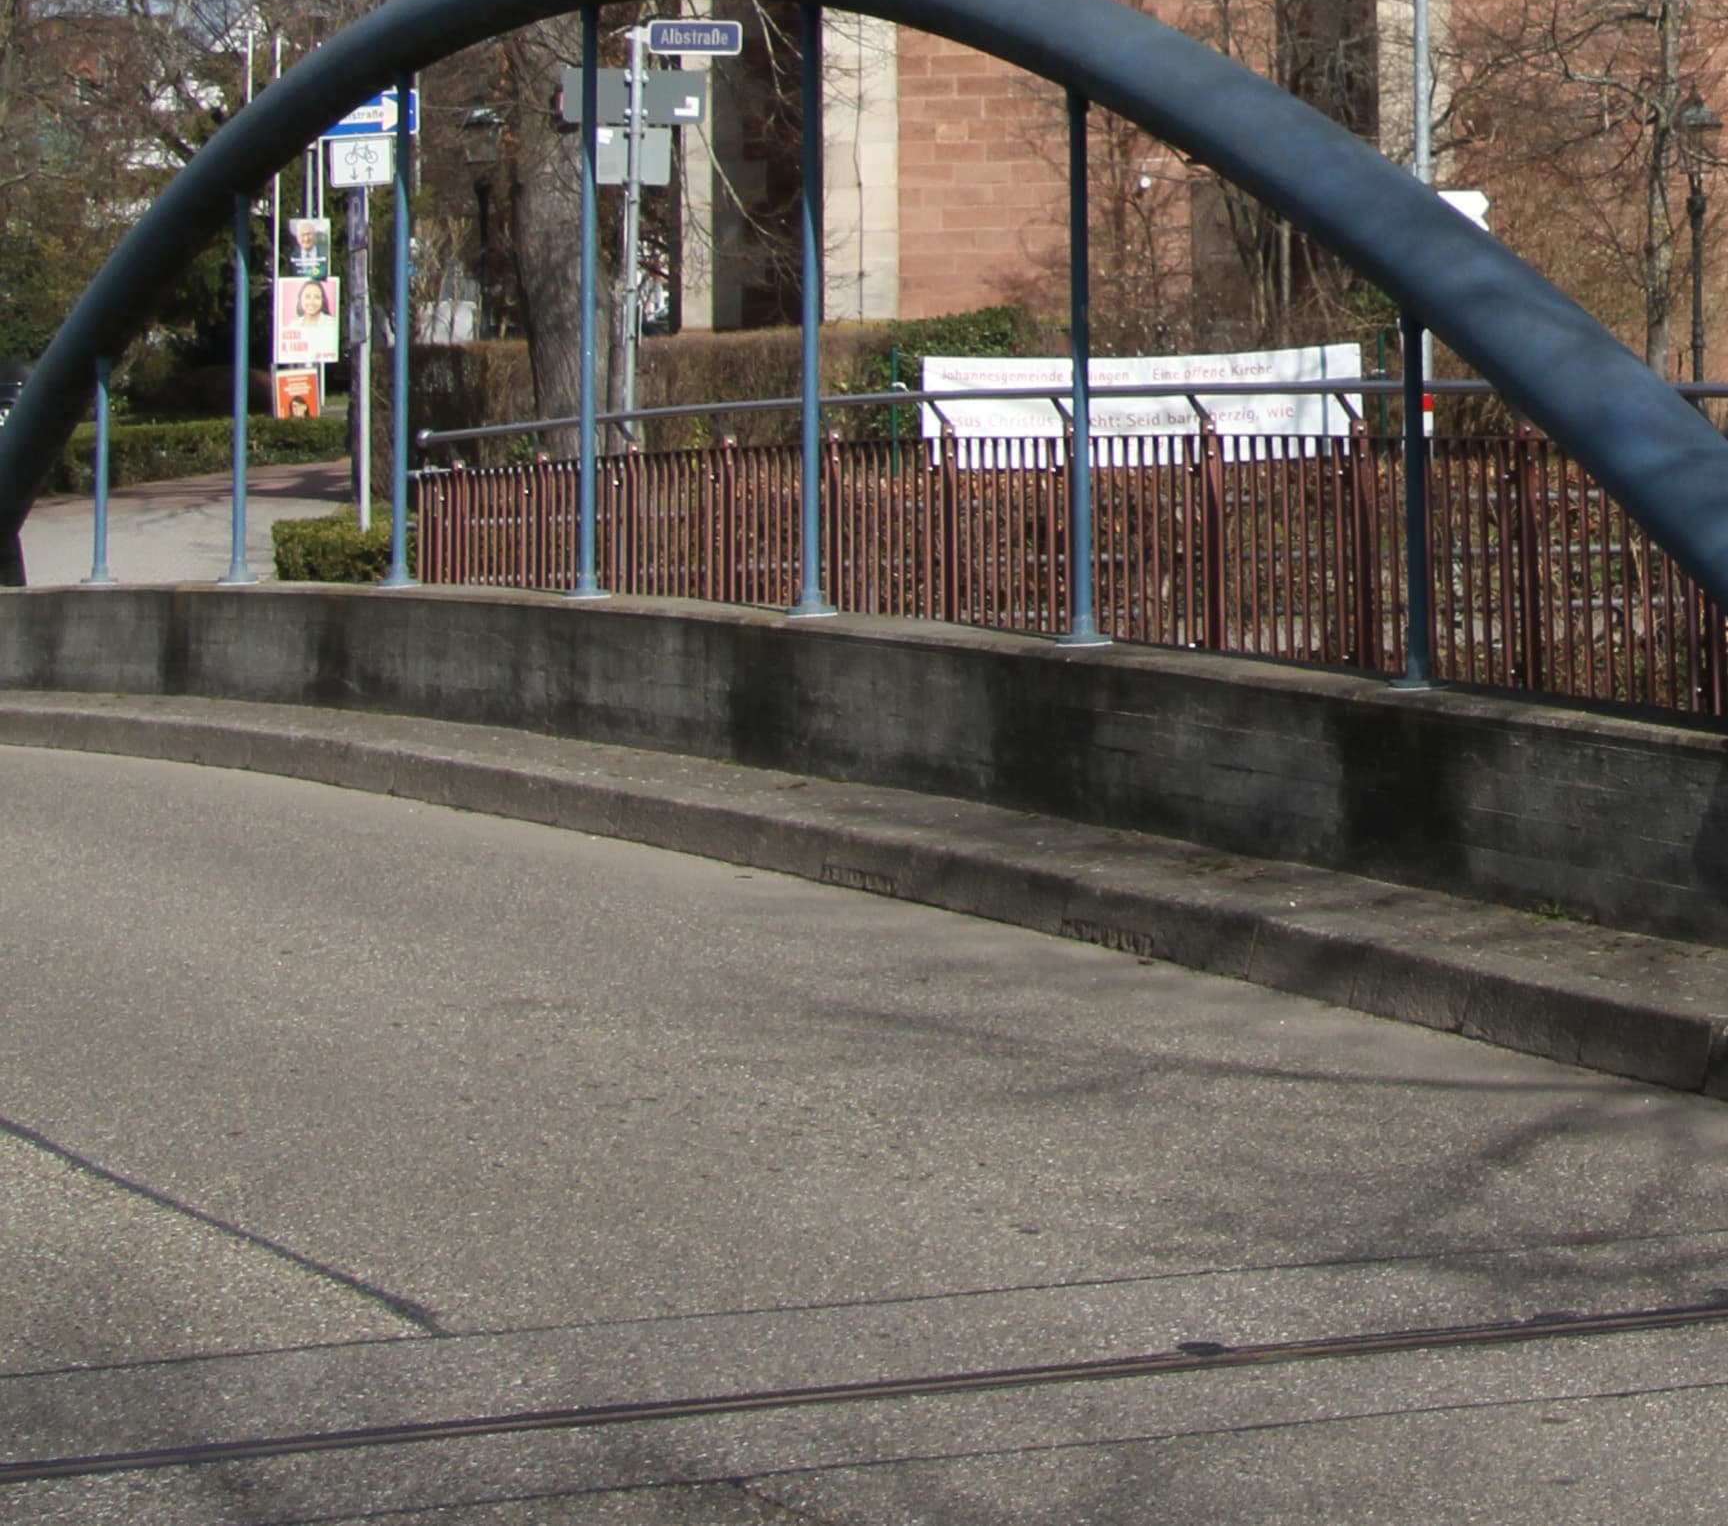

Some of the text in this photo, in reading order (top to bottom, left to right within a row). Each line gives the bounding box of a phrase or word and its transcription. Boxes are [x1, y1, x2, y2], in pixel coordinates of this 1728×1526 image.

[660, 27, 729, 46] Albstraße
[1152, 367, 1178, 381] Eine
[1184, 364, 1225, 380] offene
[1231, 361, 1273, 377] Kirche
[988, 412, 1054, 428] Christus
[1127, 412, 1160, 427] Seid
[1267, 403, 1294, 419] wie
